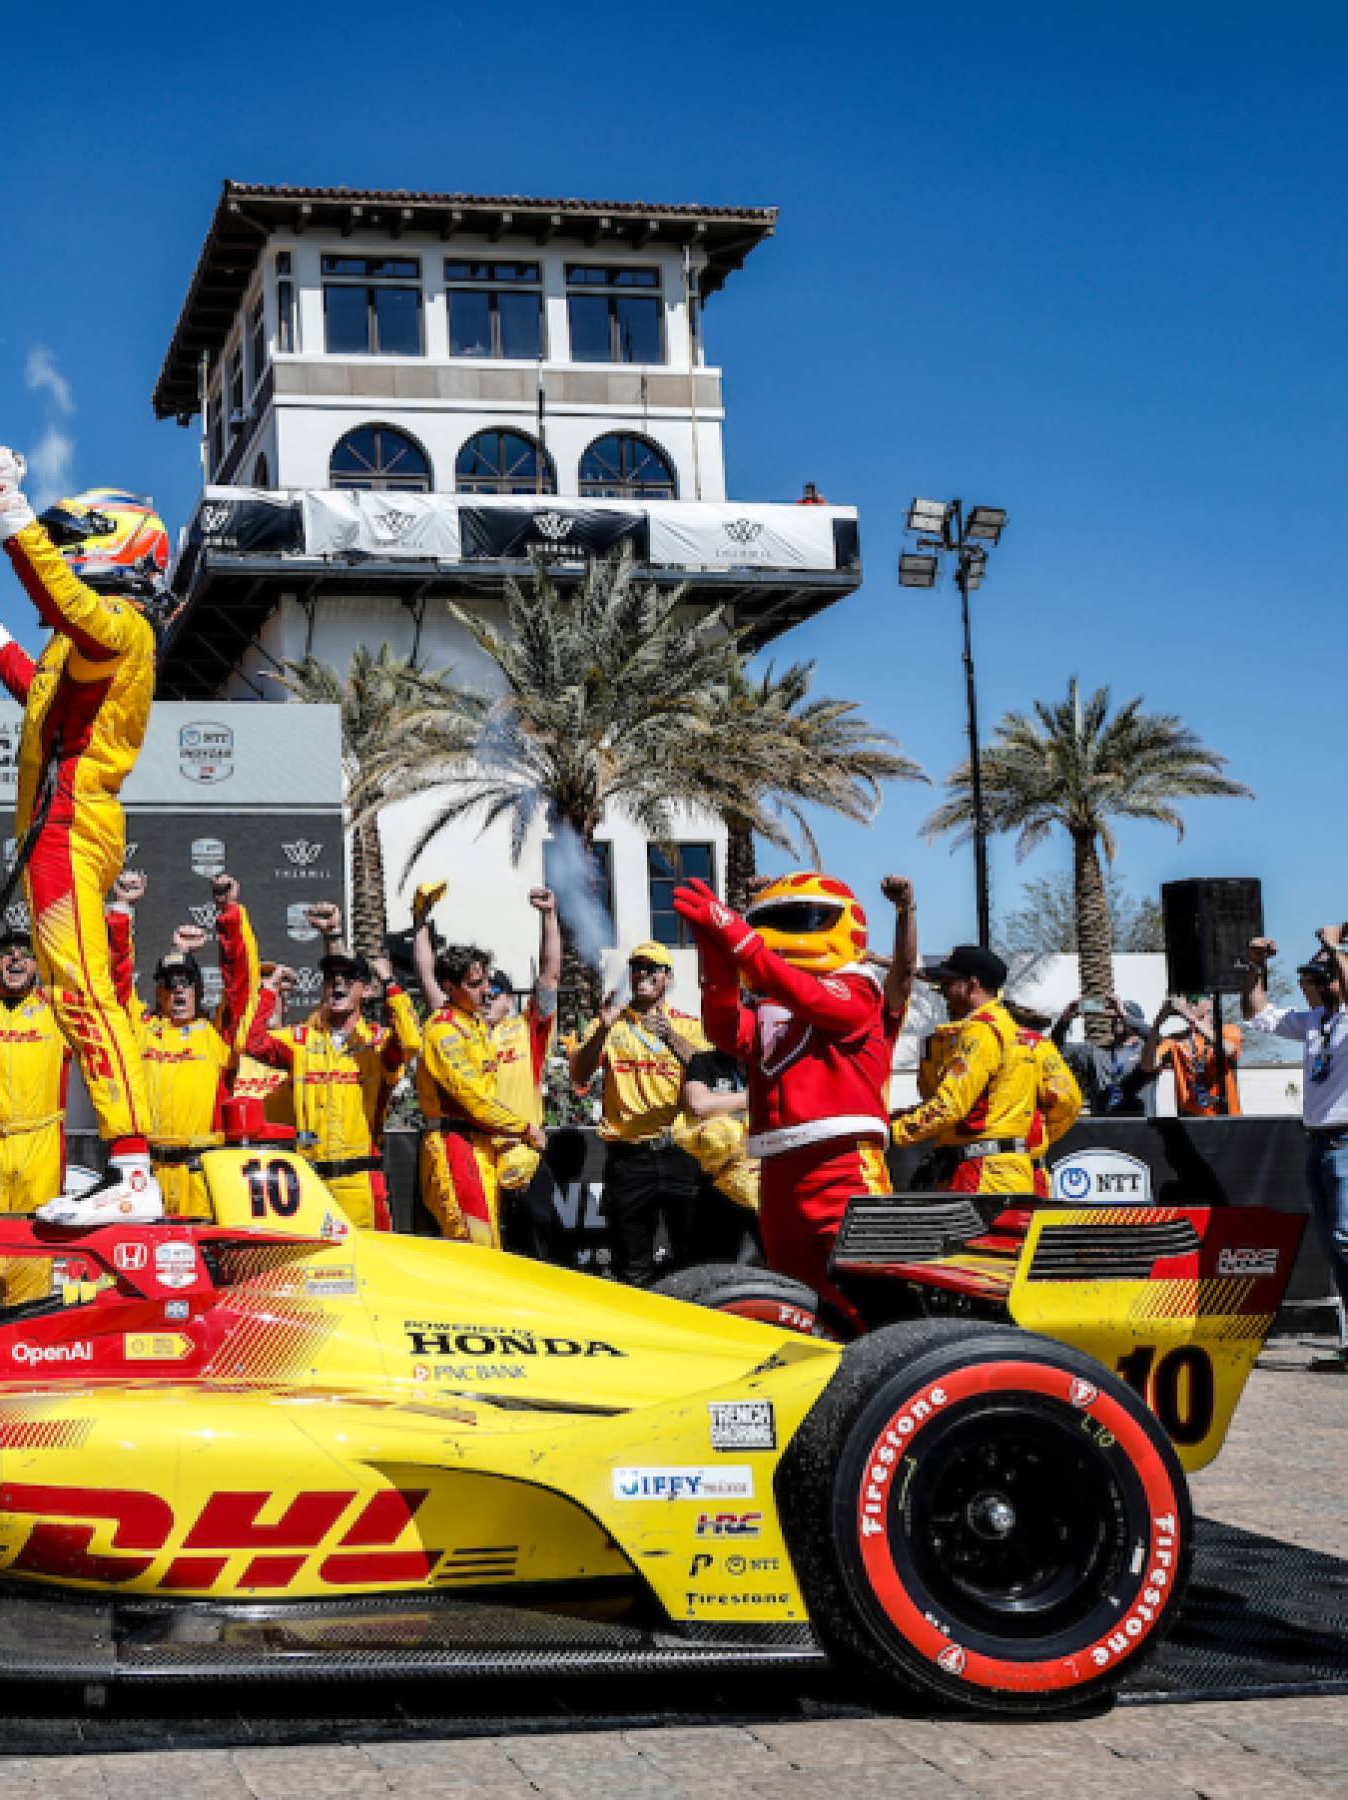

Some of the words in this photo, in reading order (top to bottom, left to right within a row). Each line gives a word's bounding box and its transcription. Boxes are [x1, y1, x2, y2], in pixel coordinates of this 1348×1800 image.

[241, 1158, 300, 1218] 10
[1095, 1173, 1142, 1193] NTT
[10, 1340, 93, 1366] OpenAI
[404, 1331, 630, 1357] HONDA
[861, 1386, 948, 1537] Firestone
[695, 1514, 762, 1534] HRC
[685, 1592, 790, 1607] Firestone
[1088, 1511, 1176, 1668] Firestone
